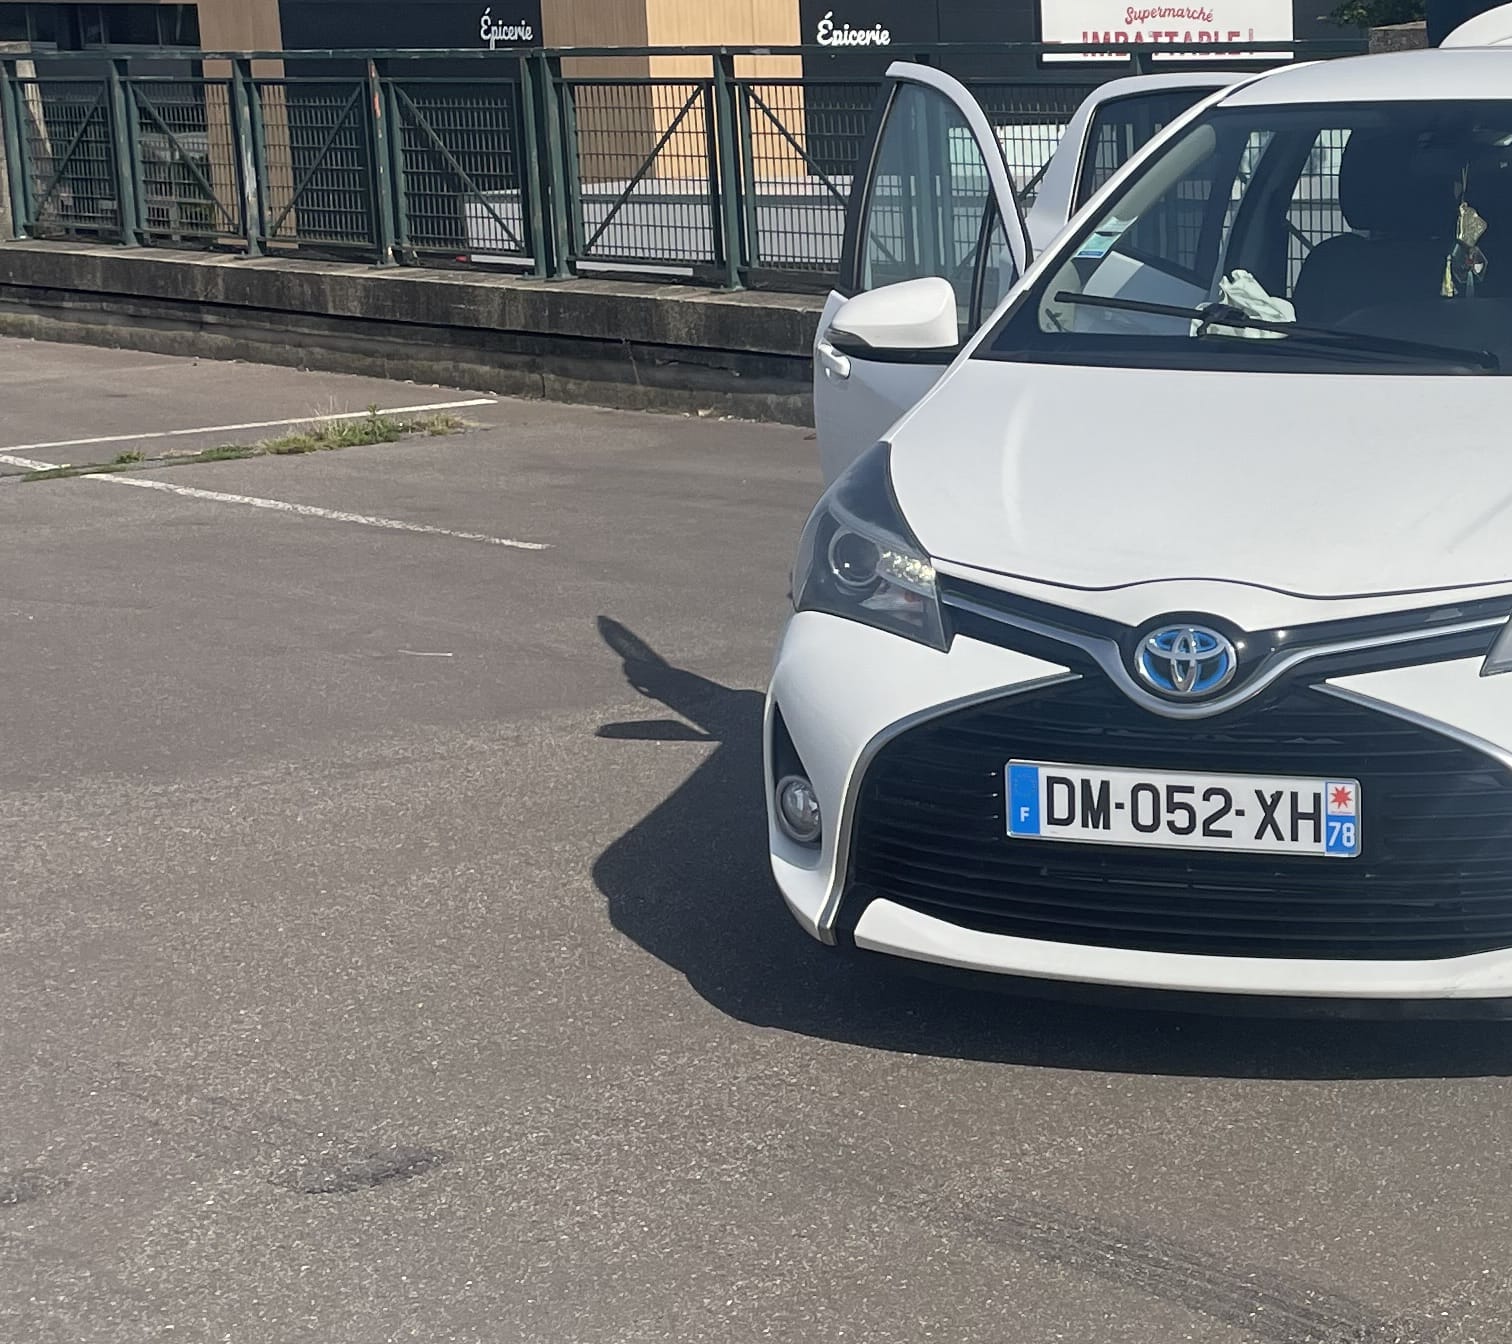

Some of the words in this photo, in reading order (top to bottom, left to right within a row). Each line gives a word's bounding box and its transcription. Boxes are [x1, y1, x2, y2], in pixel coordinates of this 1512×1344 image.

[480, 7, 533, 50] Épicerie
[1124, 6, 1214, 25] Supermarché
[1020, 806, 1030, 822] F
[1046, 775, 1322, 843] DM-052-XH
[1327, 821, 1356, 848] 78
